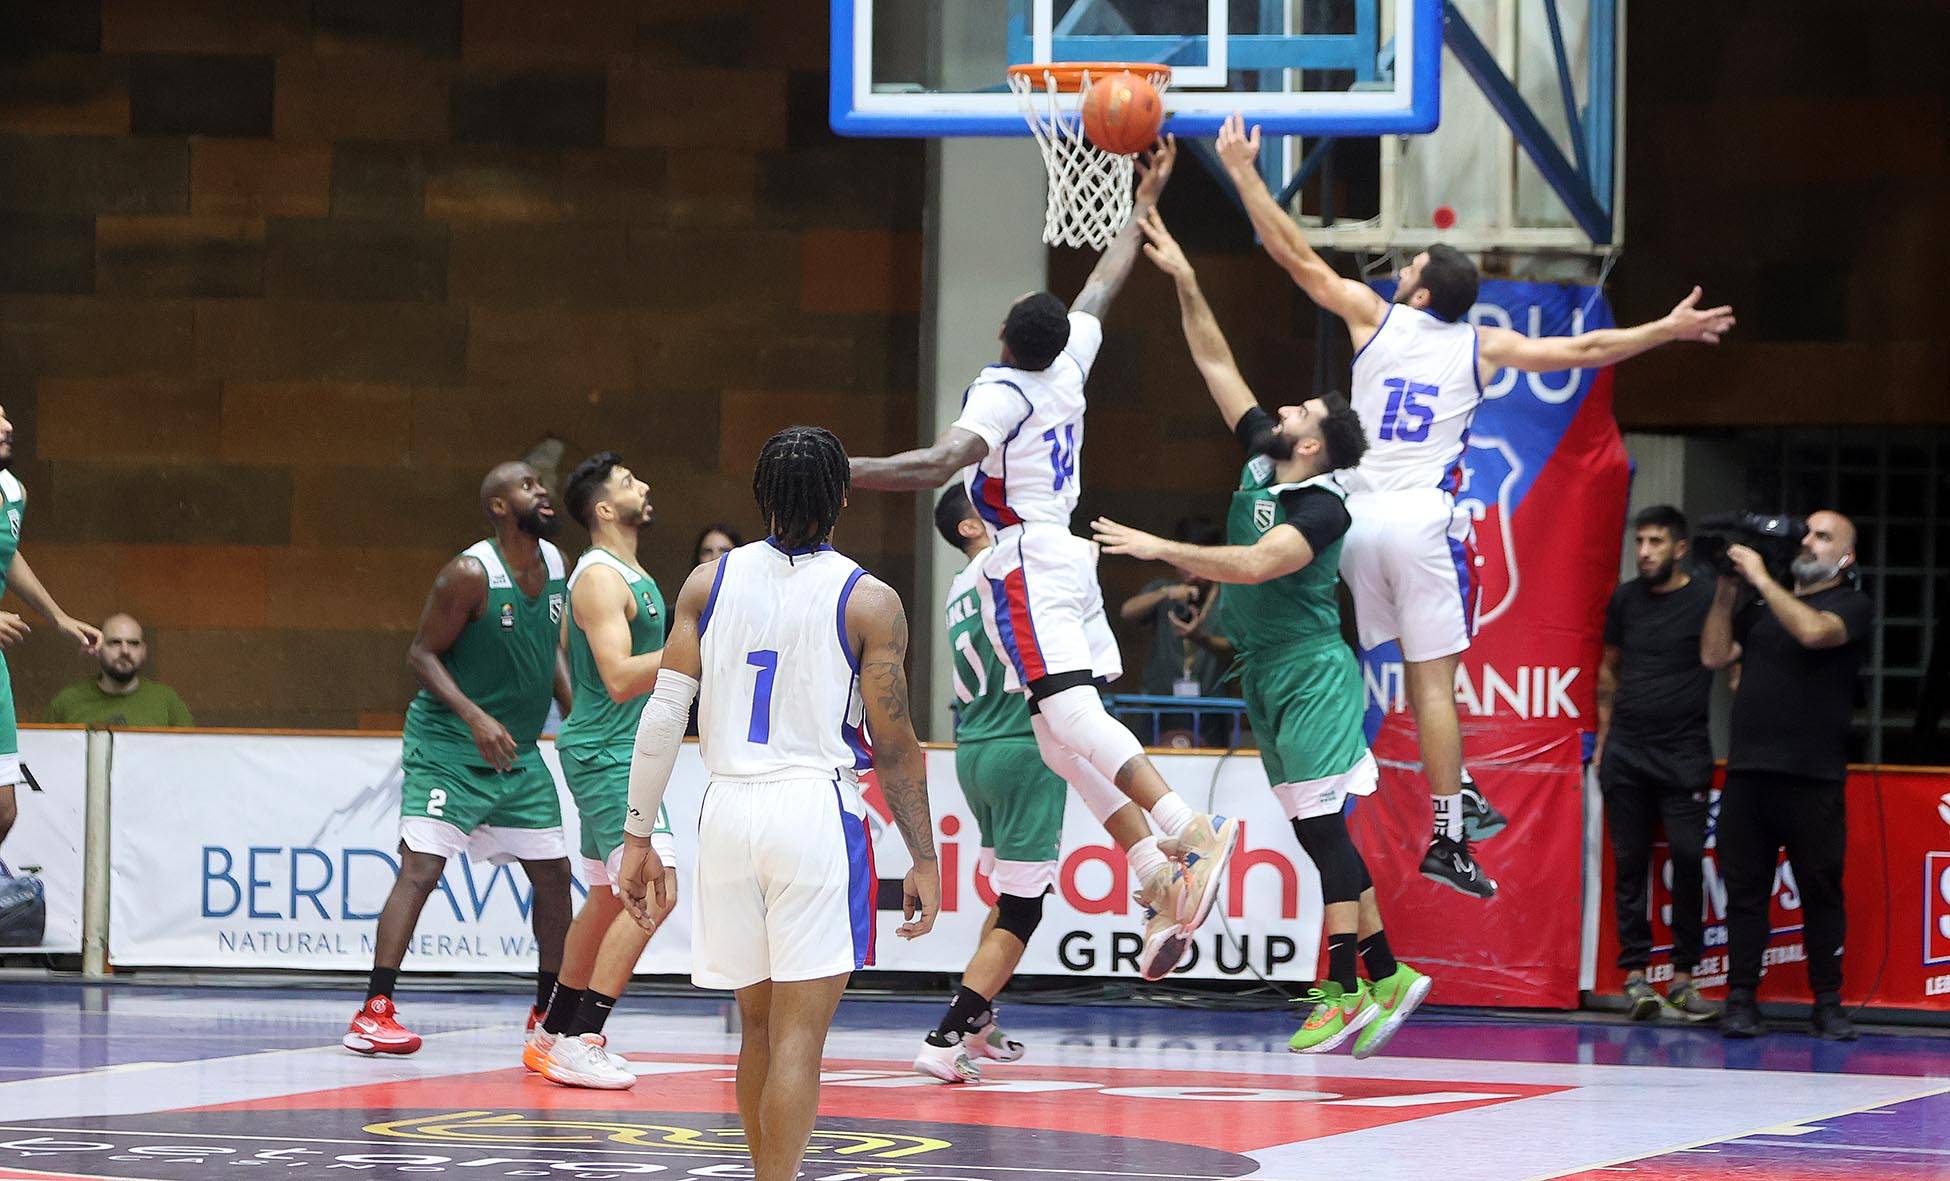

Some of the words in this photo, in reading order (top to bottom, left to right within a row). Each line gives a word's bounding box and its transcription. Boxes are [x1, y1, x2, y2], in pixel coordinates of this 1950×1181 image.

[1379, 377, 1439, 443] 15
[1043, 425, 1074, 491] 14
[746, 649, 778, 745] 1
[1363, 661, 1582, 721] NTANIK
[426, 788, 447, 817] 2
[218, 928, 348, 954] NATURAL
